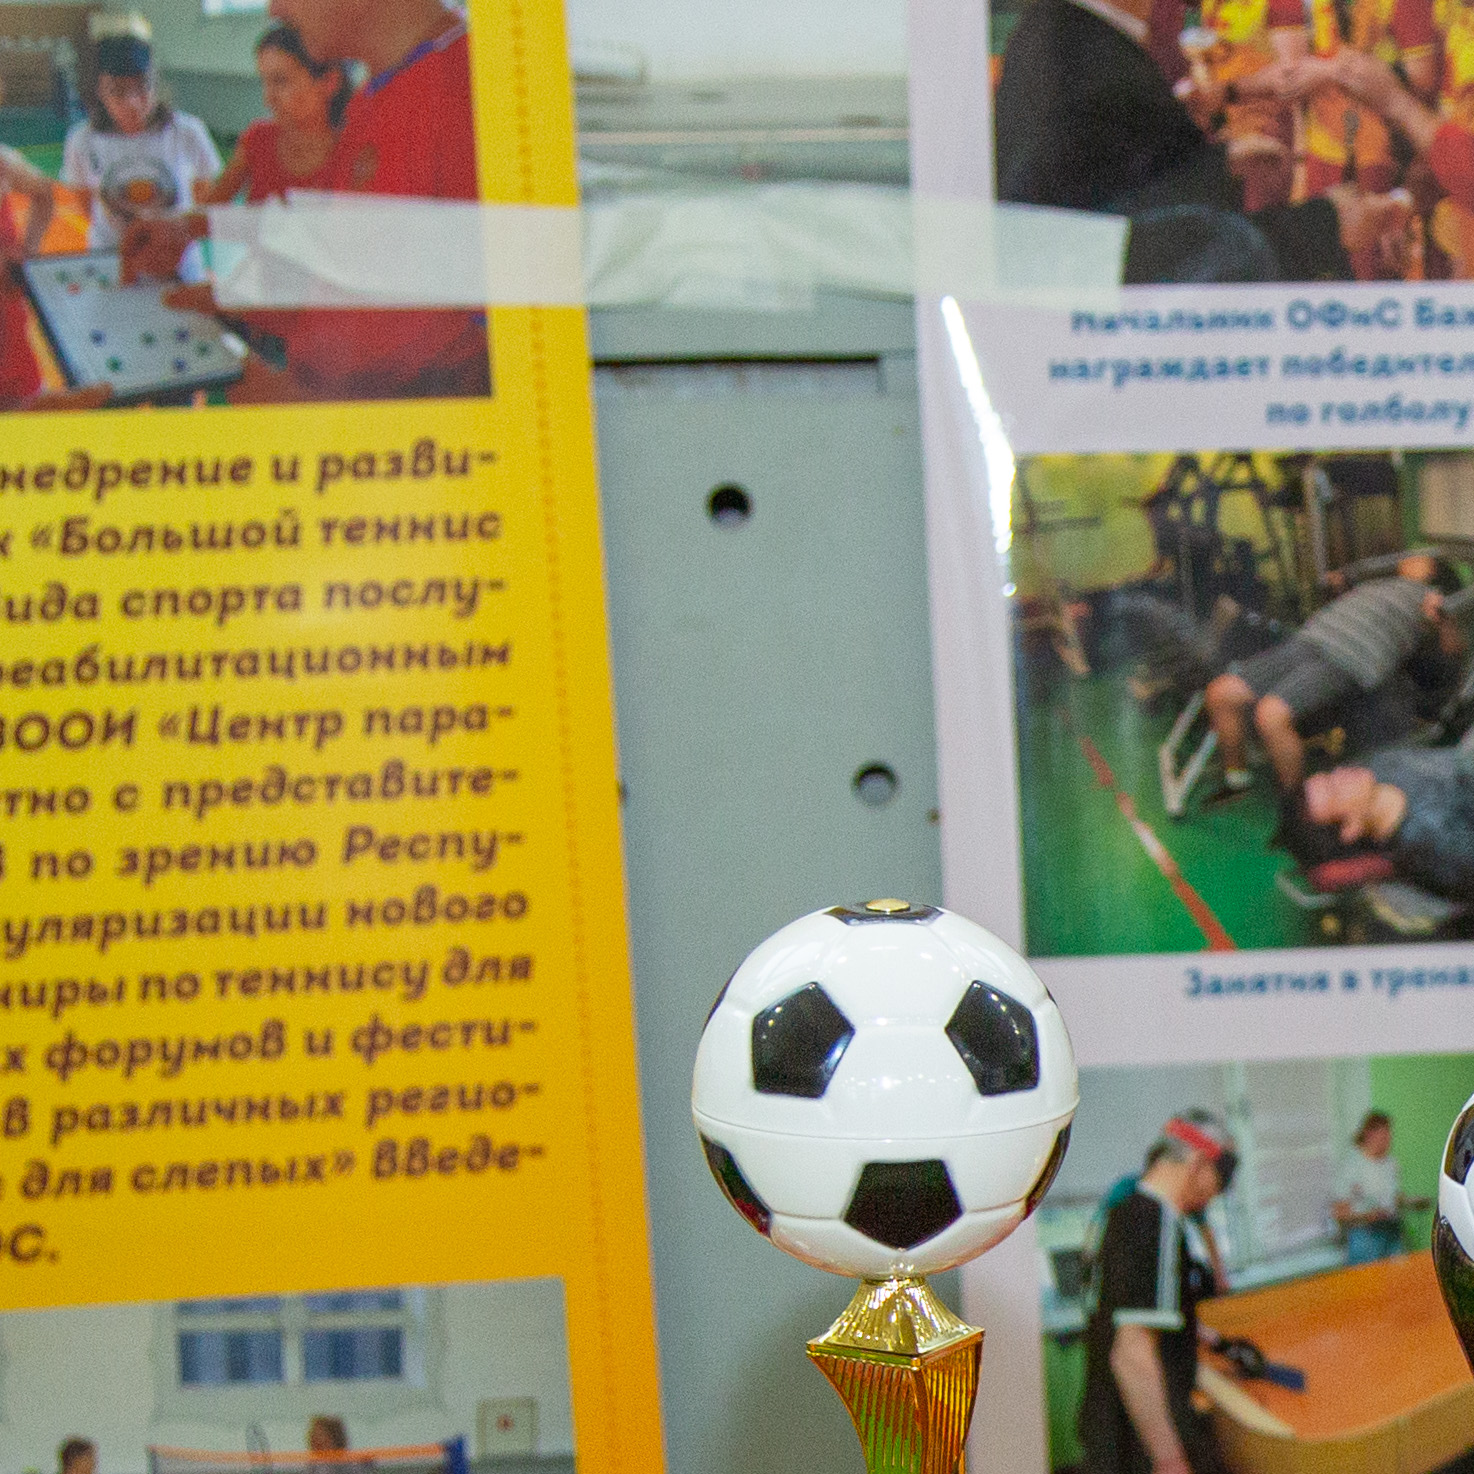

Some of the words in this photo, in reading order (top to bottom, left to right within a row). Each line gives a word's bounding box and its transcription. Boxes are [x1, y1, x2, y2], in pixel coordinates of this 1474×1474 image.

[1050, 354, 1271, 392] награждает
[1266, 401, 1312, 427] по
[1320, 392, 1474, 432] голболу
[271, 454, 300, 484] и
[312, 436, 497, 495] разви-
[28, 507, 300, 558] «Большой
[318, 510, 502, 547] теннис
[120, 582, 304, 628] спорта
[323, 575, 507, 621] послу-
[0, 640, 513, 688] еабилитационным
[157, 702, 344, 756] «Центр
[362, 703, 517, 748] пара-
[112, 780, 142, 814] с
[162, 757, 522, 822] представите-
[31, 849, 95, 880] по
[116, 838, 316, 890] зрению
[343, 823, 527, 874] Респу-
[345, 882, 531, 931] нового
[140, 970, 200, 1003] по
[214, 958, 431, 1002] теннису
[442, 945, 536, 988] для
[1186, 966, 1331, 997] Занятия
[1341, 970, 1361, 992] в
[44, 1017, 287, 1084] форумов
[304, 1027, 334, 1058] и
[349, 1012, 538, 1066] фести-
[50, 1089, 345, 1146] различных
[364, 1079, 542, 1131] регио-
[20, 1158, 114, 1200] для
[131, 1147, 356, 1193] слепых»
[371, 1133, 546, 1180] введе-
